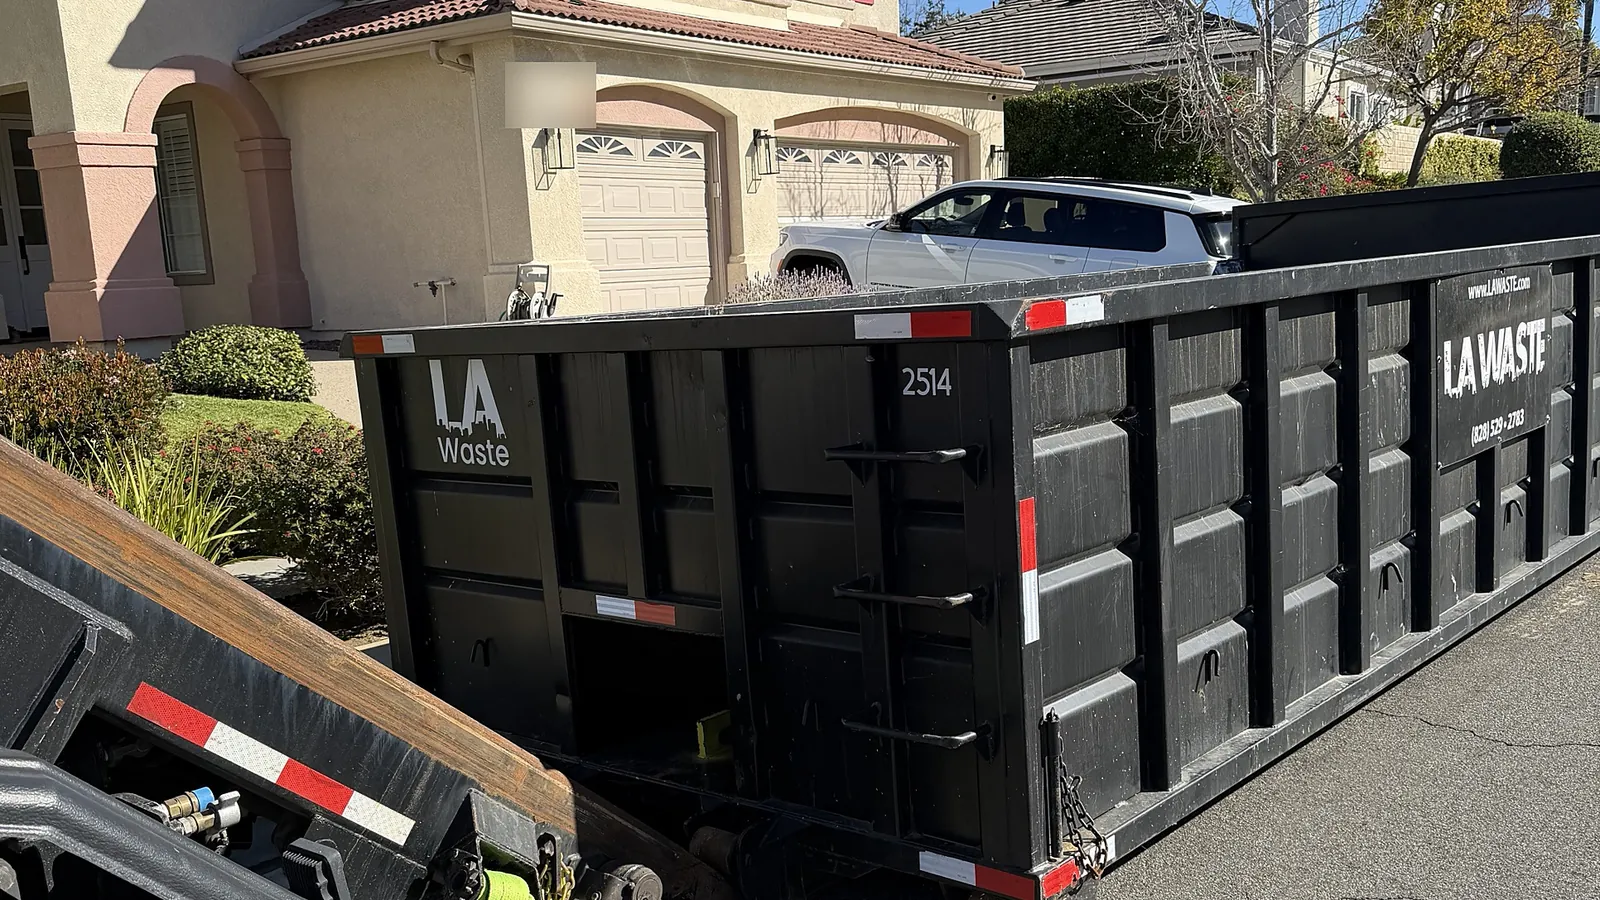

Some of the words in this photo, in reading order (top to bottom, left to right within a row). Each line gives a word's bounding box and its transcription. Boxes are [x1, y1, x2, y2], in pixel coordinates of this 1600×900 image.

[1468, 275, 1530, 299] www.LAWASTE.com
[1443, 336, 1477, 399] LA
[1477, 318, 1546, 389] WASTE
[902, 367, 952, 396] 2514
[428, 359, 507, 439] LA
[1471, 420, 1490, 447] (828)
[437, 437, 510, 467] Waste
